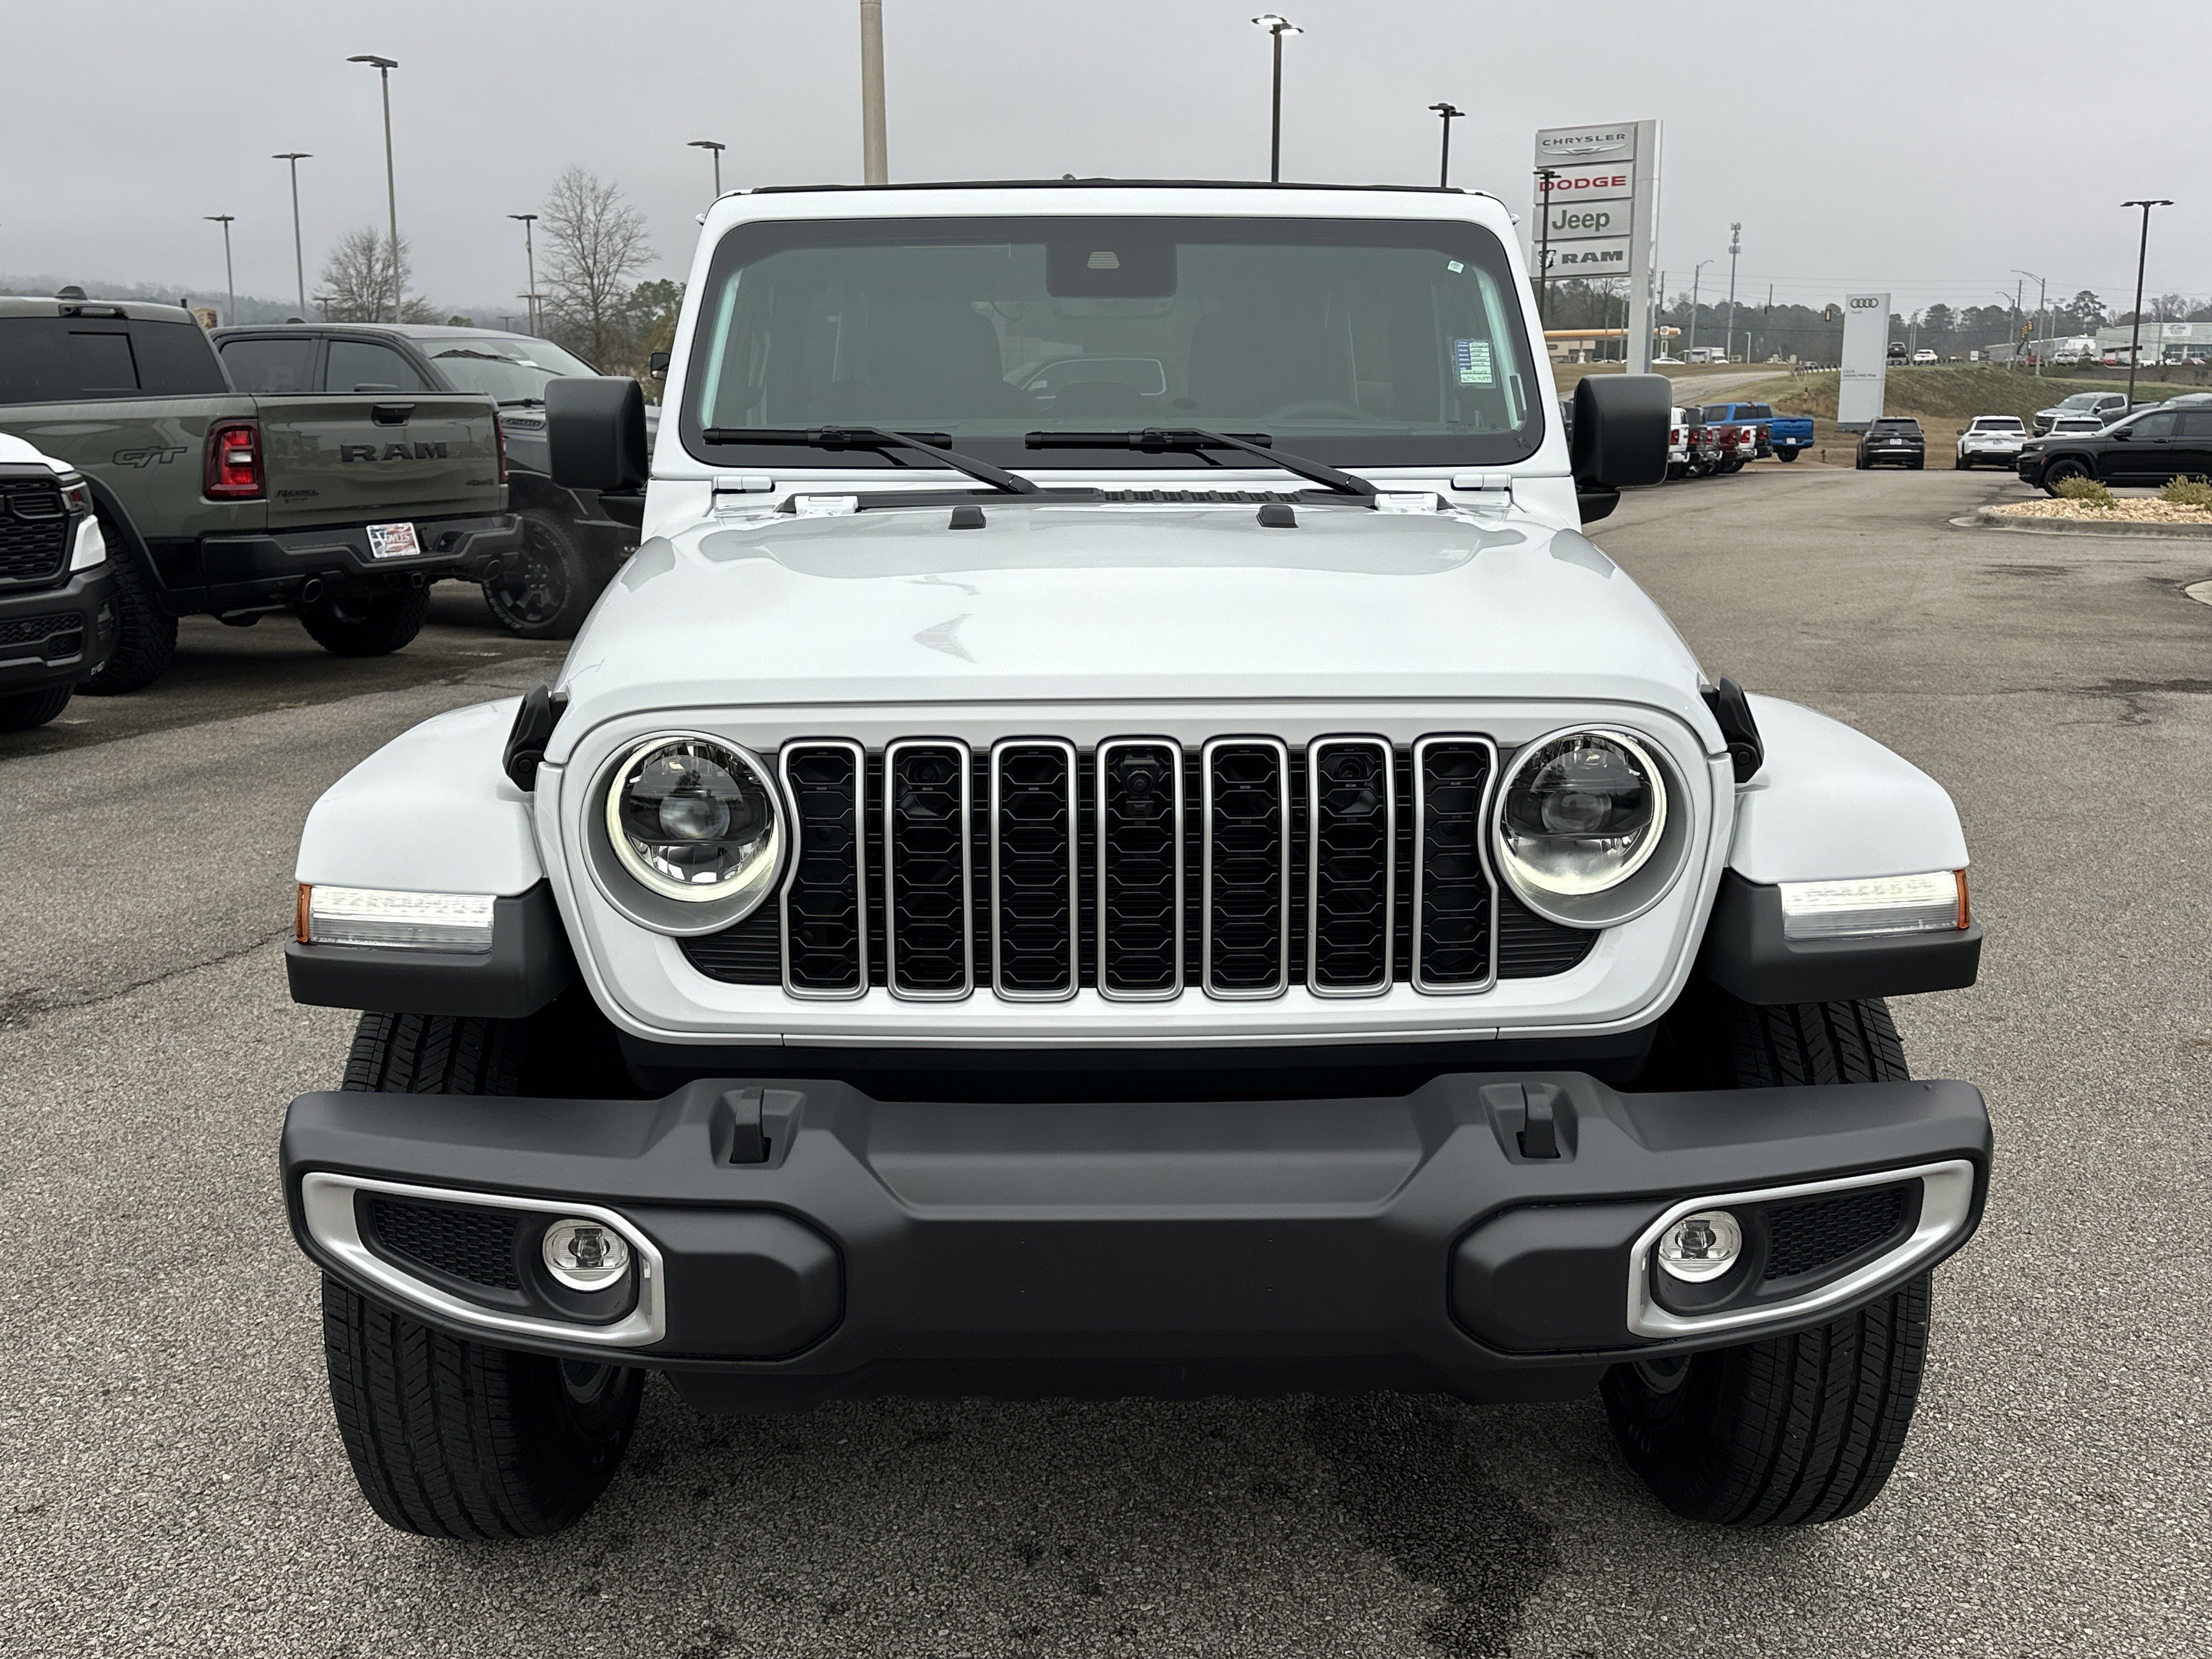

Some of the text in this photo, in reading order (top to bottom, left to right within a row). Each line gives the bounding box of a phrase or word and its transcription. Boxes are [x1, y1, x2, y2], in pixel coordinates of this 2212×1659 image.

[1542, 133, 1626, 146] CHRYSLER
[1539, 176, 1626, 191] DODGE
[1552, 210, 1610, 232] Jeep
[1562, 251, 1624, 264] RAM
[340, 441, 448, 462] RAM
